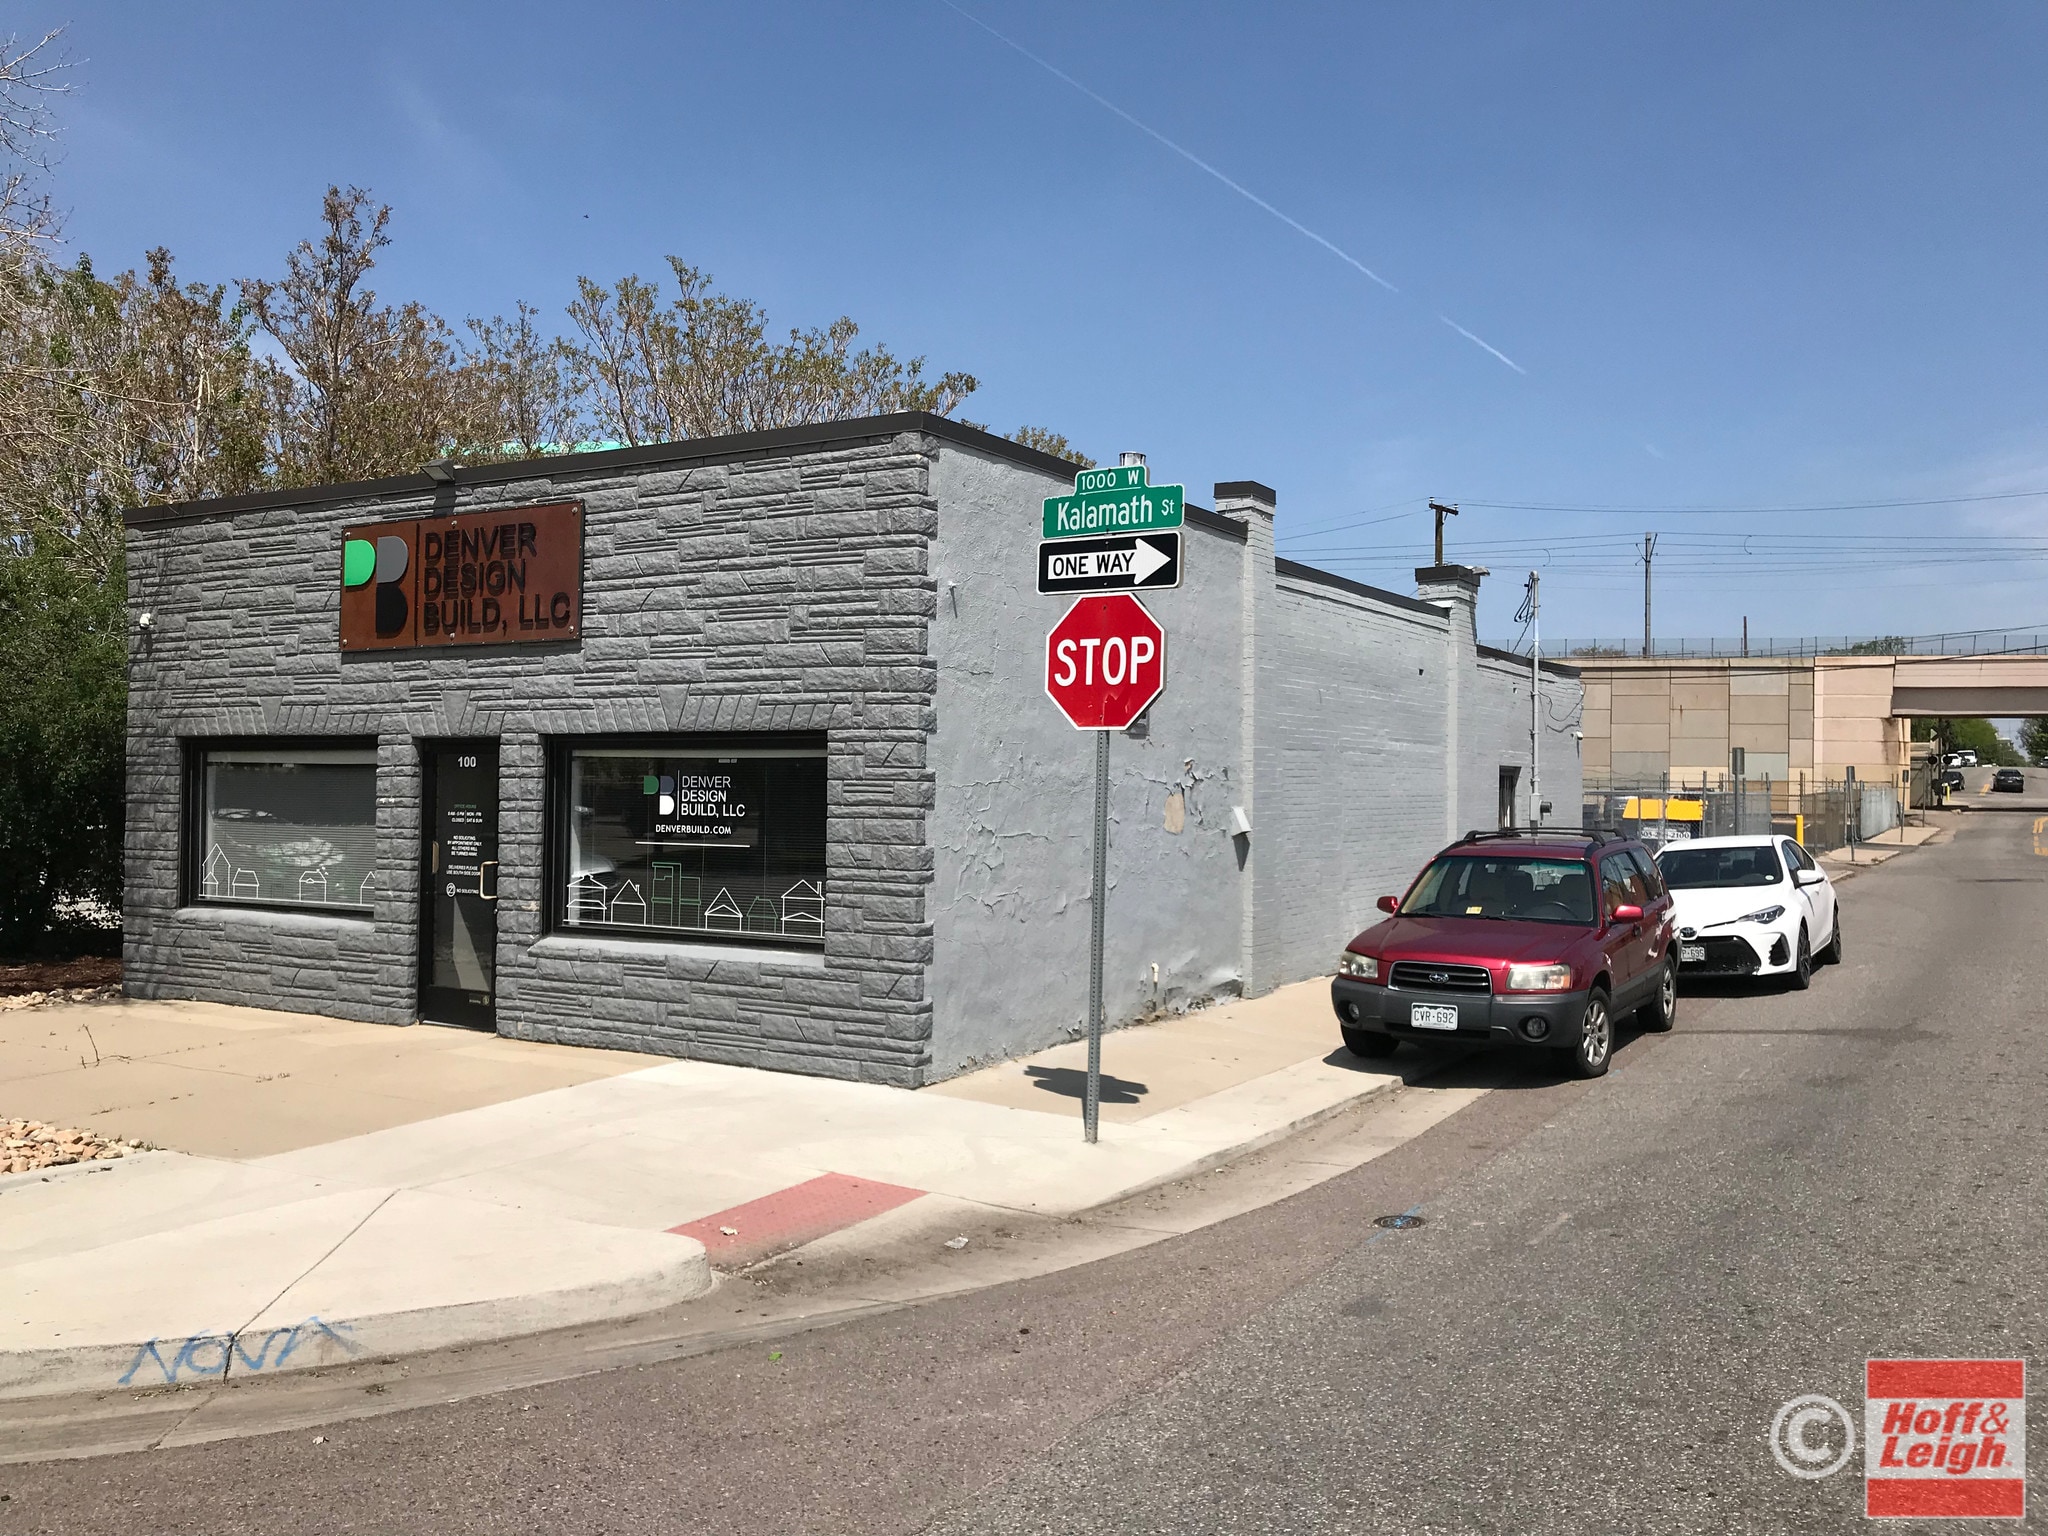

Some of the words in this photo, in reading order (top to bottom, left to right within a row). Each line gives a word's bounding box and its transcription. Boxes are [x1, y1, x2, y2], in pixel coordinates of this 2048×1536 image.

[1081, 472, 1116, 490] 1000
[1128, 470, 1140, 485] W
[1057, 494, 1152, 531] Kalamath
[1161, 499, 1175, 516] St
[425, 523, 536, 564] DENVER
[1053, 555, 1089, 577] ONE
[1096, 552, 1135, 574] WAY
[424, 558, 526, 598] DESIGN
[424, 596, 507, 636] BUILD,
[518, 592, 571, 631] LLC
[1054, 636, 1155, 687] STOP
[457, 756, 477, 768] 100
[682, 776, 731, 788] DENVER
[681, 789, 727, 802] DESIGN
[681, 803, 719, 818] BUILD,
[722, 804, 746, 817] LLC
[655, 824, 732, 835] DENVERBUILD.COM
